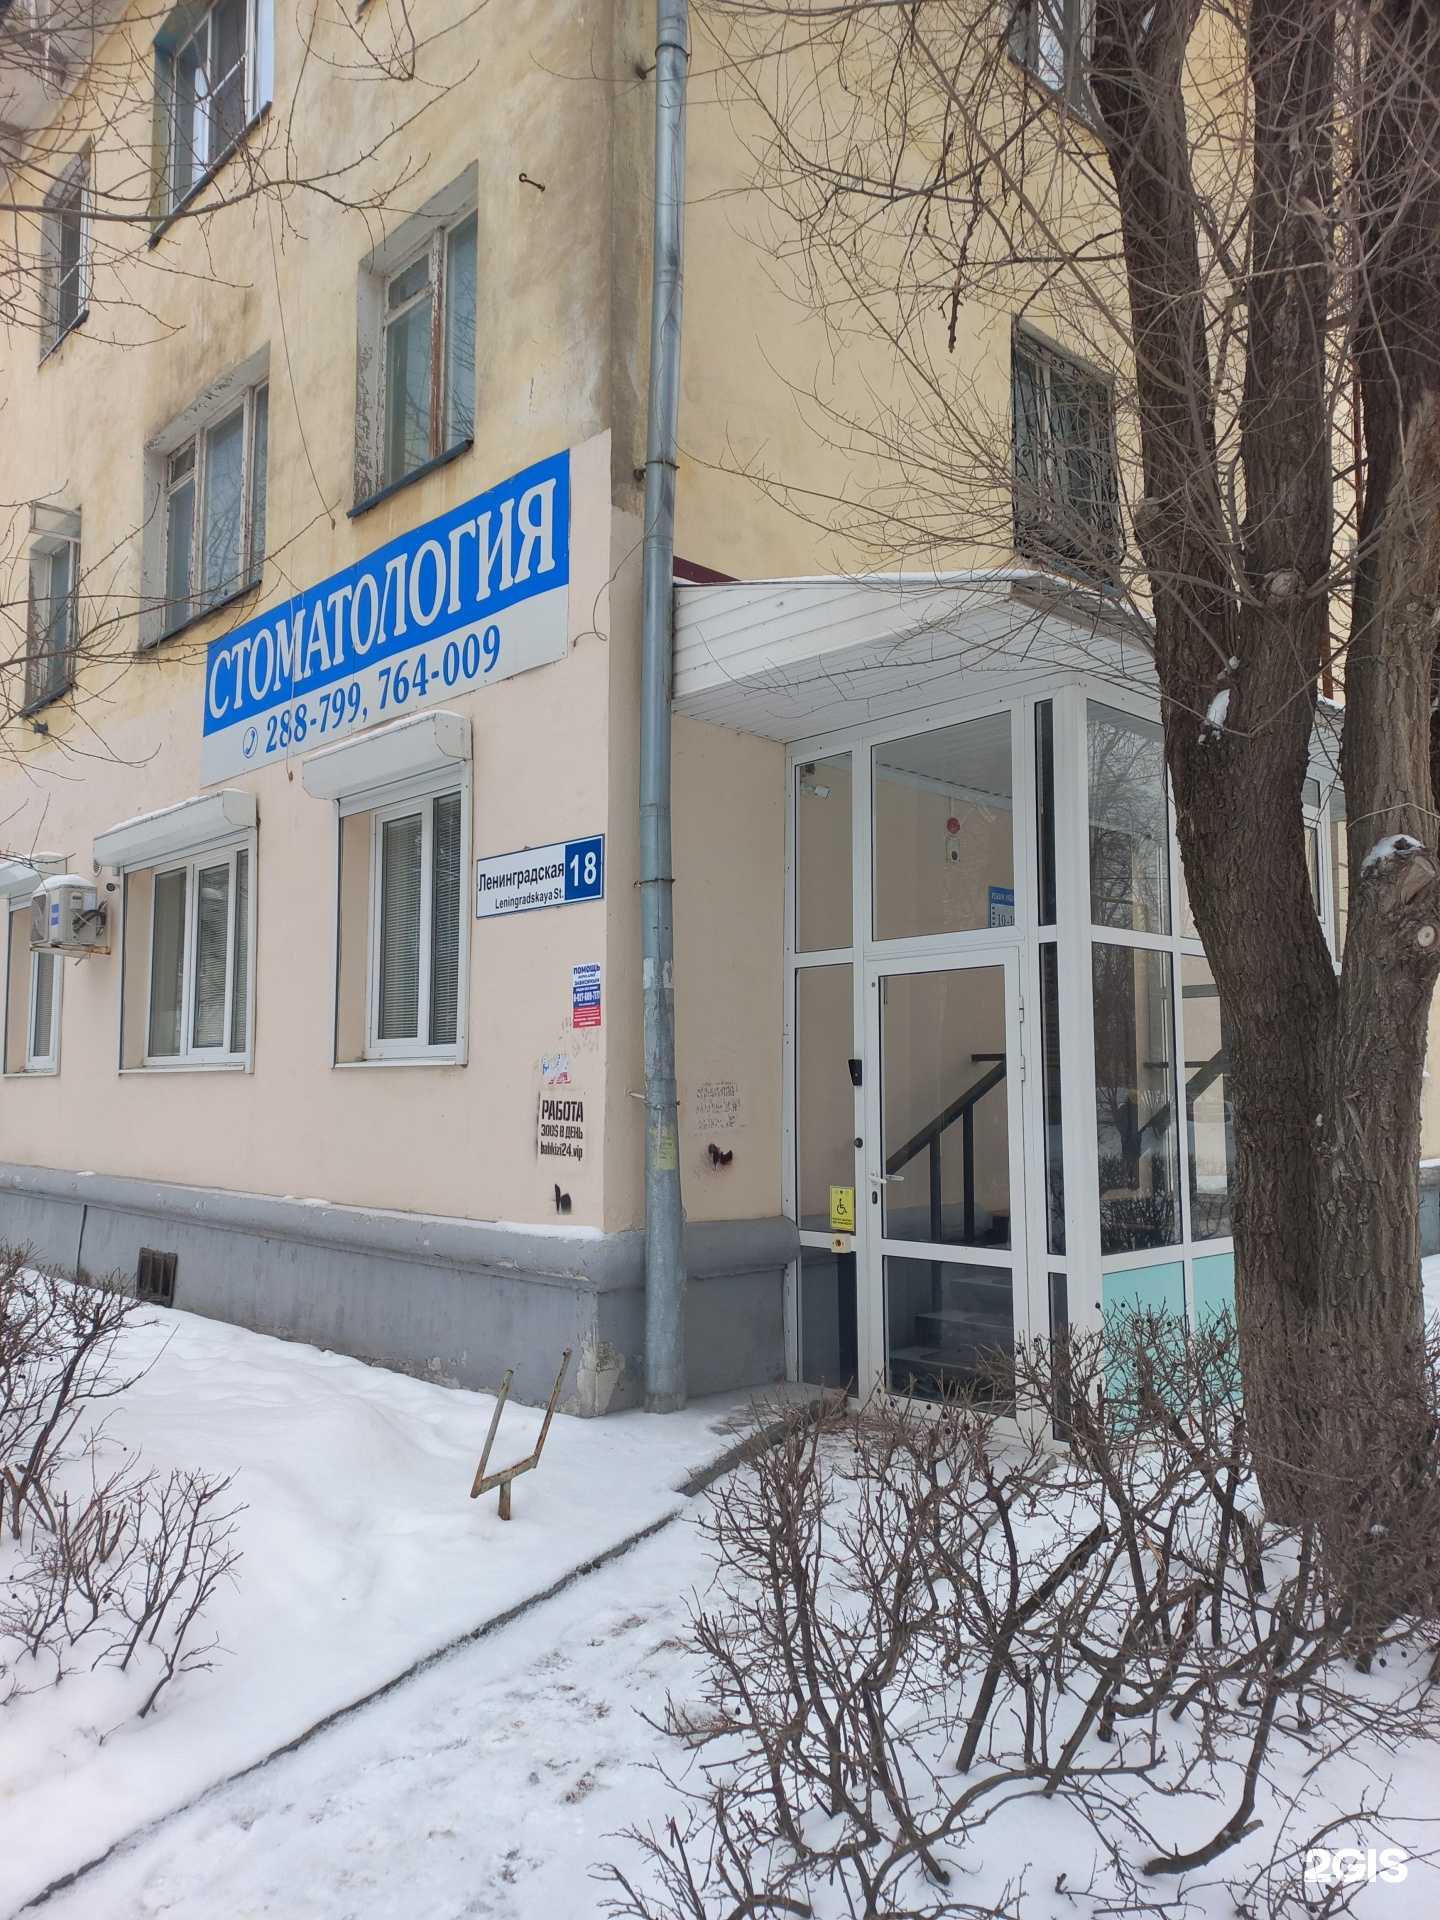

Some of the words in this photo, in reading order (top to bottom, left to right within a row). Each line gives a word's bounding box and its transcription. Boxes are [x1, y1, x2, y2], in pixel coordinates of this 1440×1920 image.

[207, 478, 557, 719] СТОМАТОЛОГИЯ
[265, 682, 369, 753] 288-799,
[378, 624, 500, 709] 764-009
[479, 863, 564, 891] Ленинградская
[570, 851, 597, 887] 18
[495, 890, 553, 909] Leningradskaya
[553, 888, 564, 900] St.
[573, 964, 600, 976] ПОМОЩЬ
[541, 1099, 584, 1122] РАБОТА
[559, 1125, 565, 1138] В
[565, 1126, 583, 1140] ДЕНЬ
